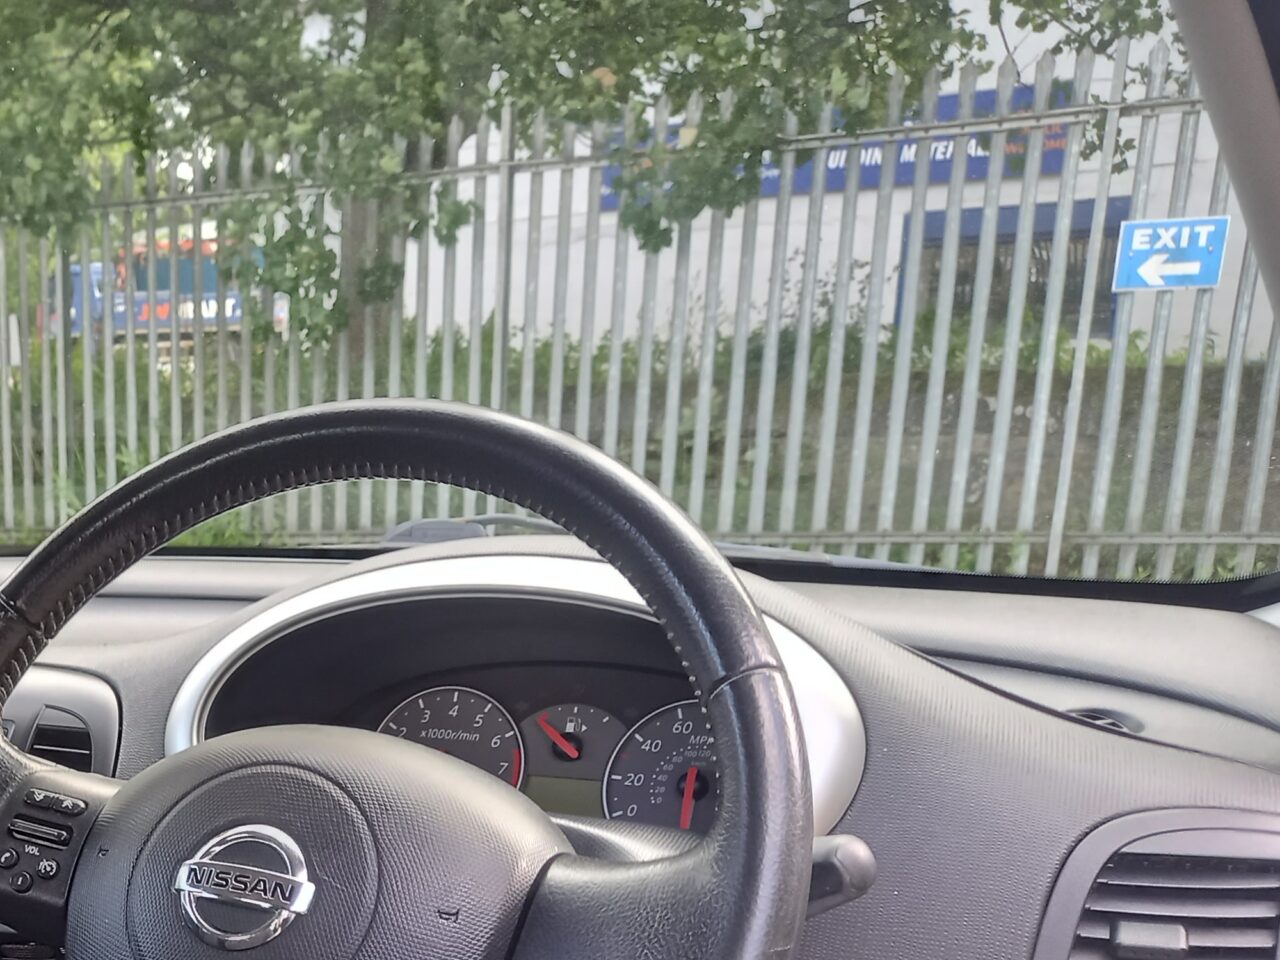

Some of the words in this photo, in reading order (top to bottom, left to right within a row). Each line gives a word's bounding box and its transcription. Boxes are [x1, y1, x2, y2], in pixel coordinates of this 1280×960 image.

[1131, 225, 1215, 250] EXIT
[420, 710, 431, 723] 3
[448, 705, 459, 717] 4
[473, 714, 484, 727] 5
[397, 727, 407, 738] 2
[672, 721, 693, 734] 60
[420, 728, 480, 742] x1000r/min
[491, 735, 501, 747] 6
[641, 739, 662, 752] 40
[498, 762, 509, 775] 7
[624, 773, 644, 786] 20
[627, 804, 637, 817] 0
[24, 844, 40, 856] VOL
[186, 865, 294, 904] NISSAN
